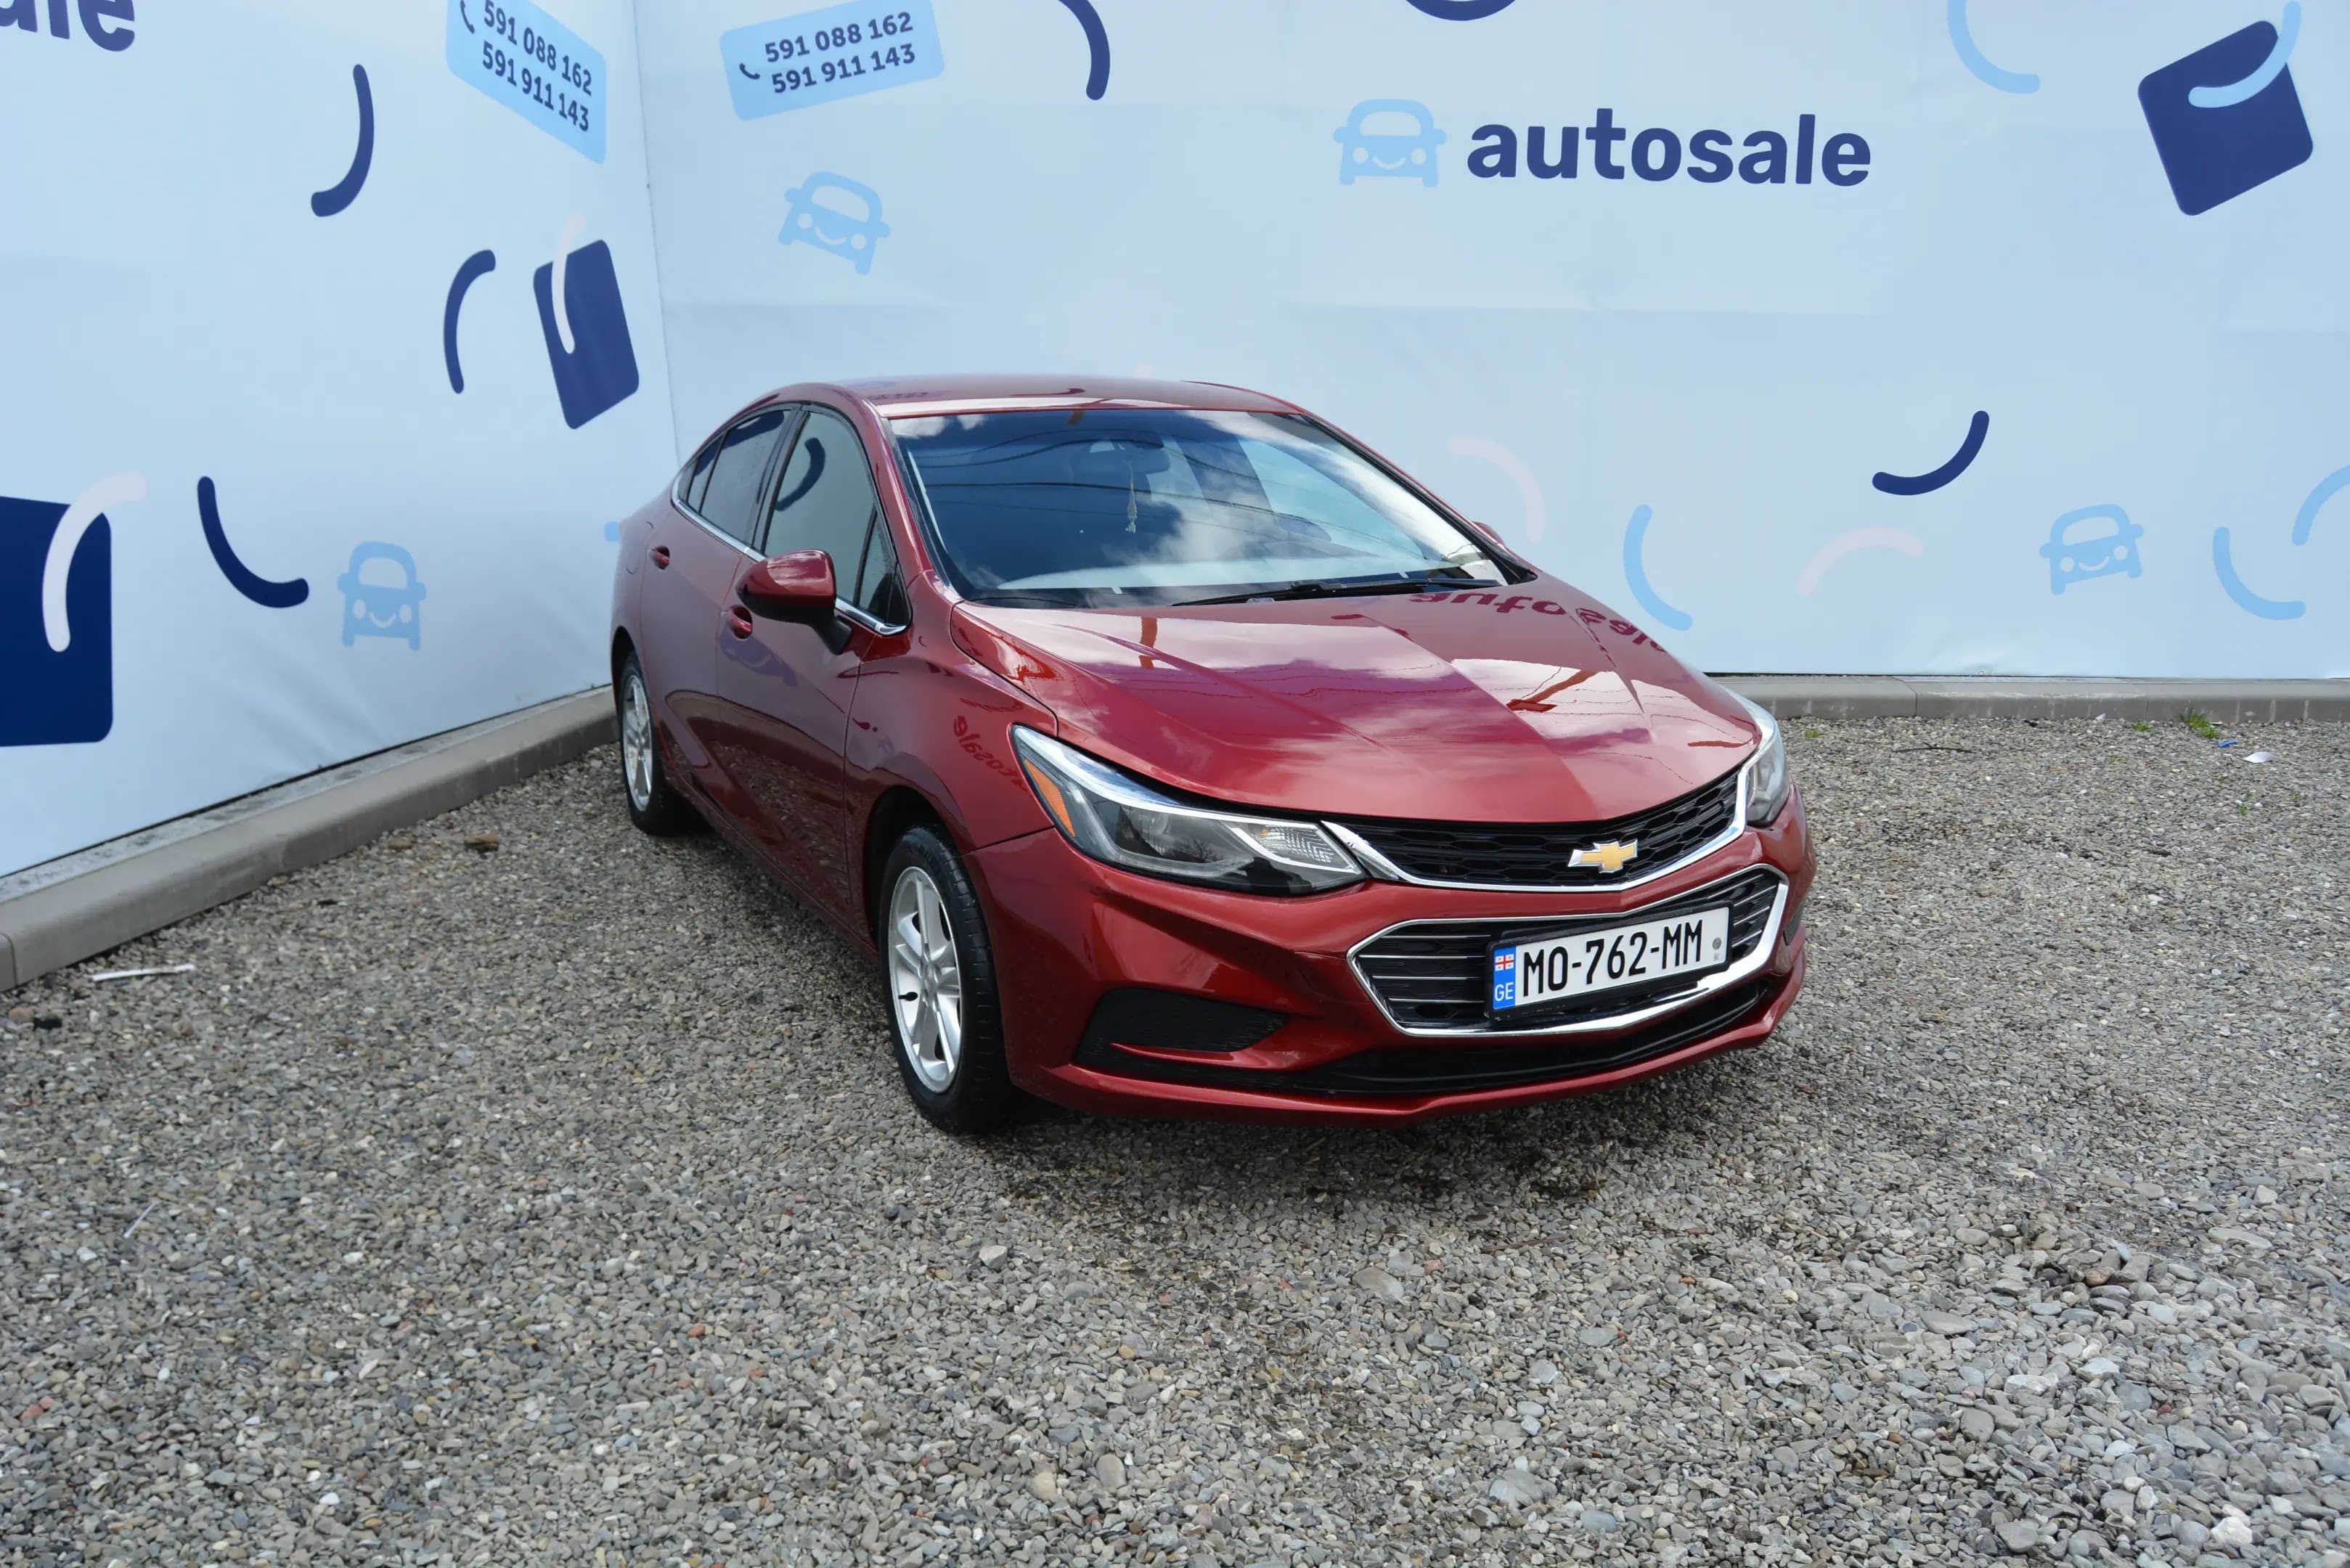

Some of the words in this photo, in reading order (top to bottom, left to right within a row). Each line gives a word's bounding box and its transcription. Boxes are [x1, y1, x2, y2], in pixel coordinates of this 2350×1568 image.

[484, 0, 517, 46] 591
[523, 27, 556, 71] 088
[561, 55, 592, 97] 162
[764, 35, 810, 63] 591
[815, 23, 862, 52] 088
[868, 12, 913, 40] 162
[771, 66, 817, 94] 591
[820, 55, 866, 83] 911
[870, 43, 915, 71] 143
[483, 40, 517, 87] 591
[521, 68, 554, 110] 911
[558, 92, 589, 132] 143
[1466, 108, 1872, 187] autosale
[1494, 981, 1514, 1003] GE
[1522, 919, 1702, 997] MO-762-MM
